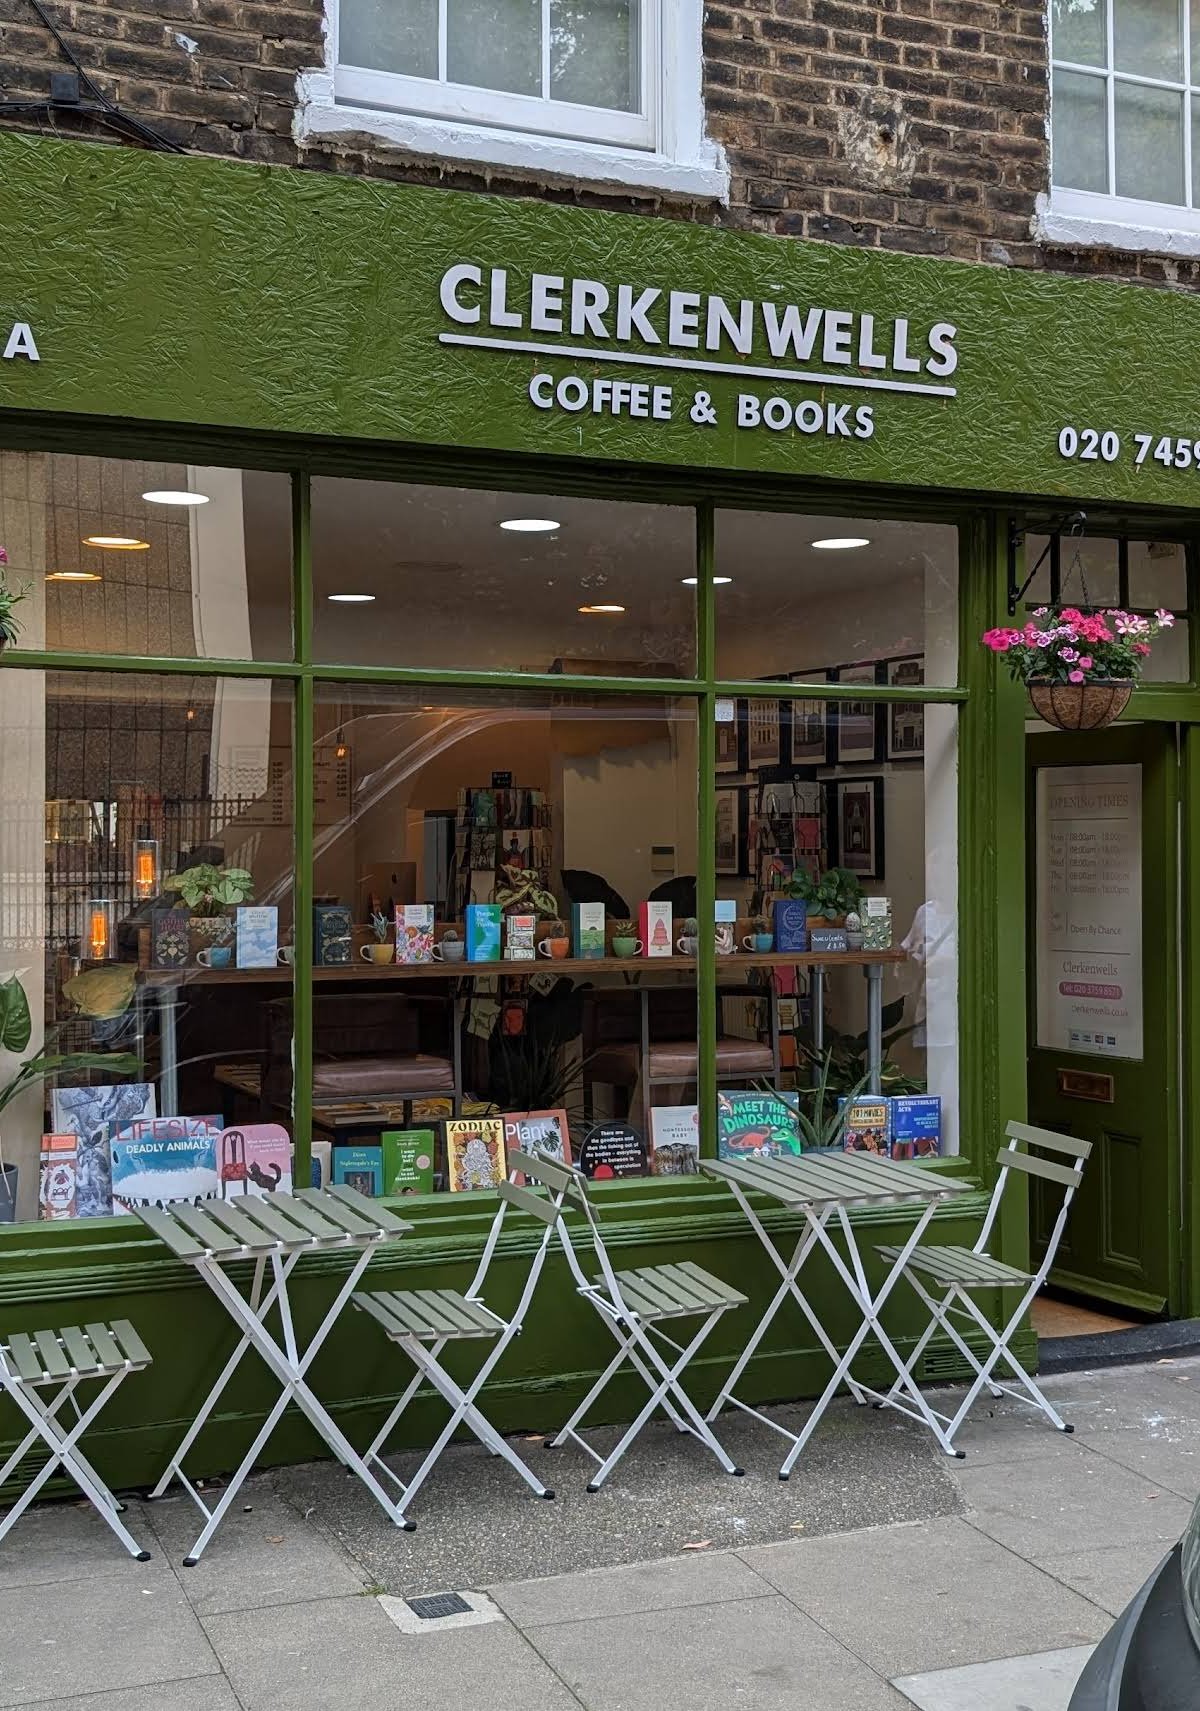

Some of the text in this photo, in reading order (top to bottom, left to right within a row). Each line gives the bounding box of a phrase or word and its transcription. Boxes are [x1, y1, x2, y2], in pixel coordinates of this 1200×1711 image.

[439, 263, 959, 378] CLERKENWELLS
[2, 322, 41, 362] A
[528, 373, 876, 440] COFFEE & BOOKS
[1058, 426, 1120, 462] 020
[1097, 792, 1128, 809] TIMES
[1063, 961, 1118, 976] Clerkenwells
[733, 1101, 786, 1114] MEET THE
[449, 1120, 501, 1132] ZODIAC
[505, 1120, 547, 1140] Plant
[723, 1113, 795, 1134] DINOSAURS
[125, 1140, 210, 1154] DEADLY ANIMALS
